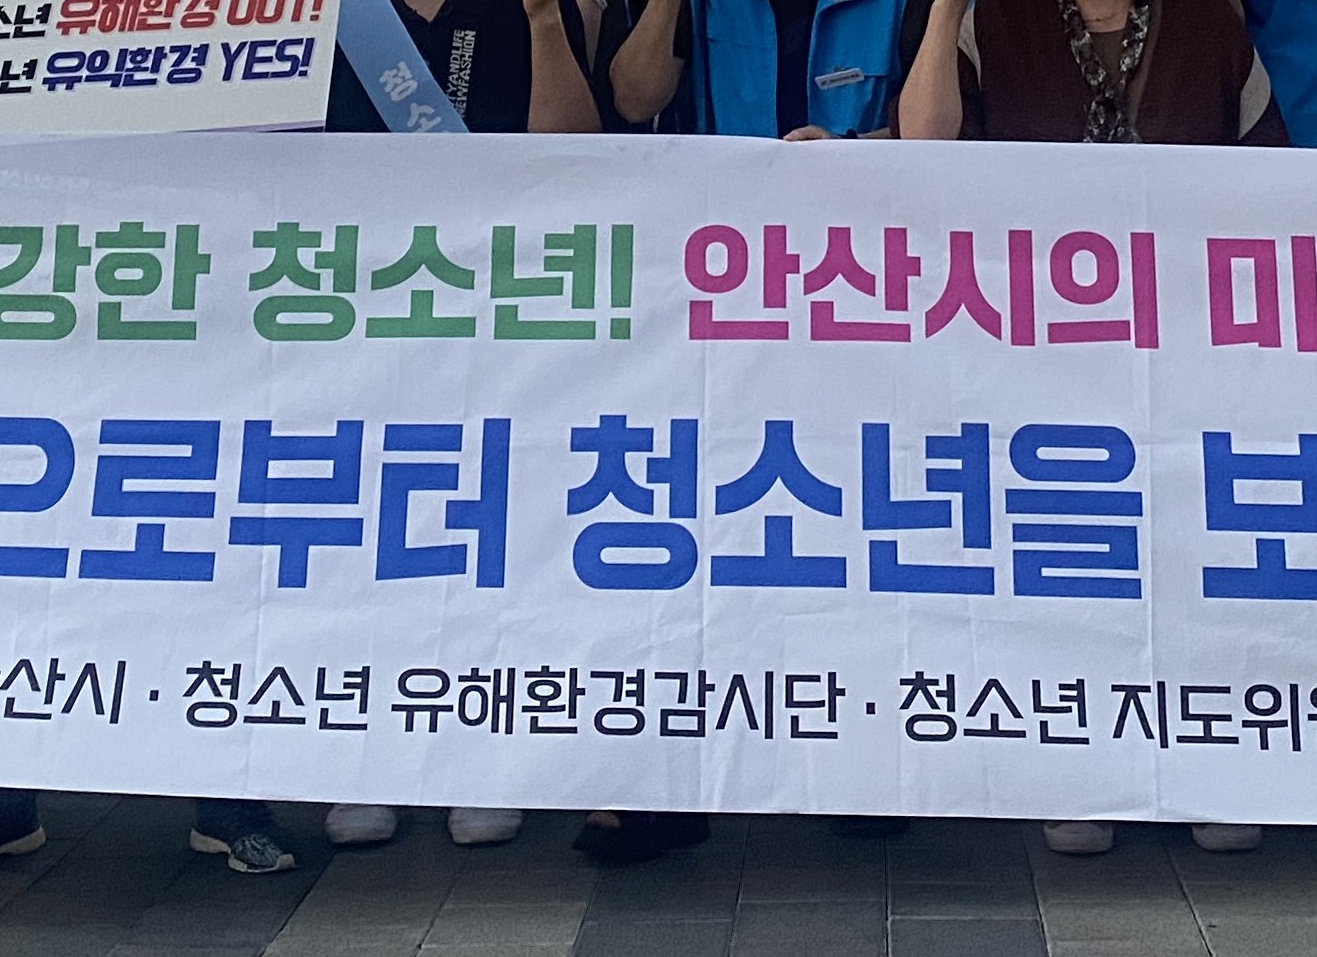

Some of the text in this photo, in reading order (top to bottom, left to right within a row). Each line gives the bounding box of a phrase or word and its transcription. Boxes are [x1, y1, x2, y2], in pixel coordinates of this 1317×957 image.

[42, 44, 208, 91] 유익환경
[220, 38, 316, 84] YES!
[248, 221, 635, 341] 청소년!
[683, 224, 1160, 350] 안산시의
[566, 414, 1144, 600] 청소년을
[183, 660, 371, 731] 청소년
[390, 665, 847, 740] 유해환경감시단
[898, 670, 1090, 745] 청소년
